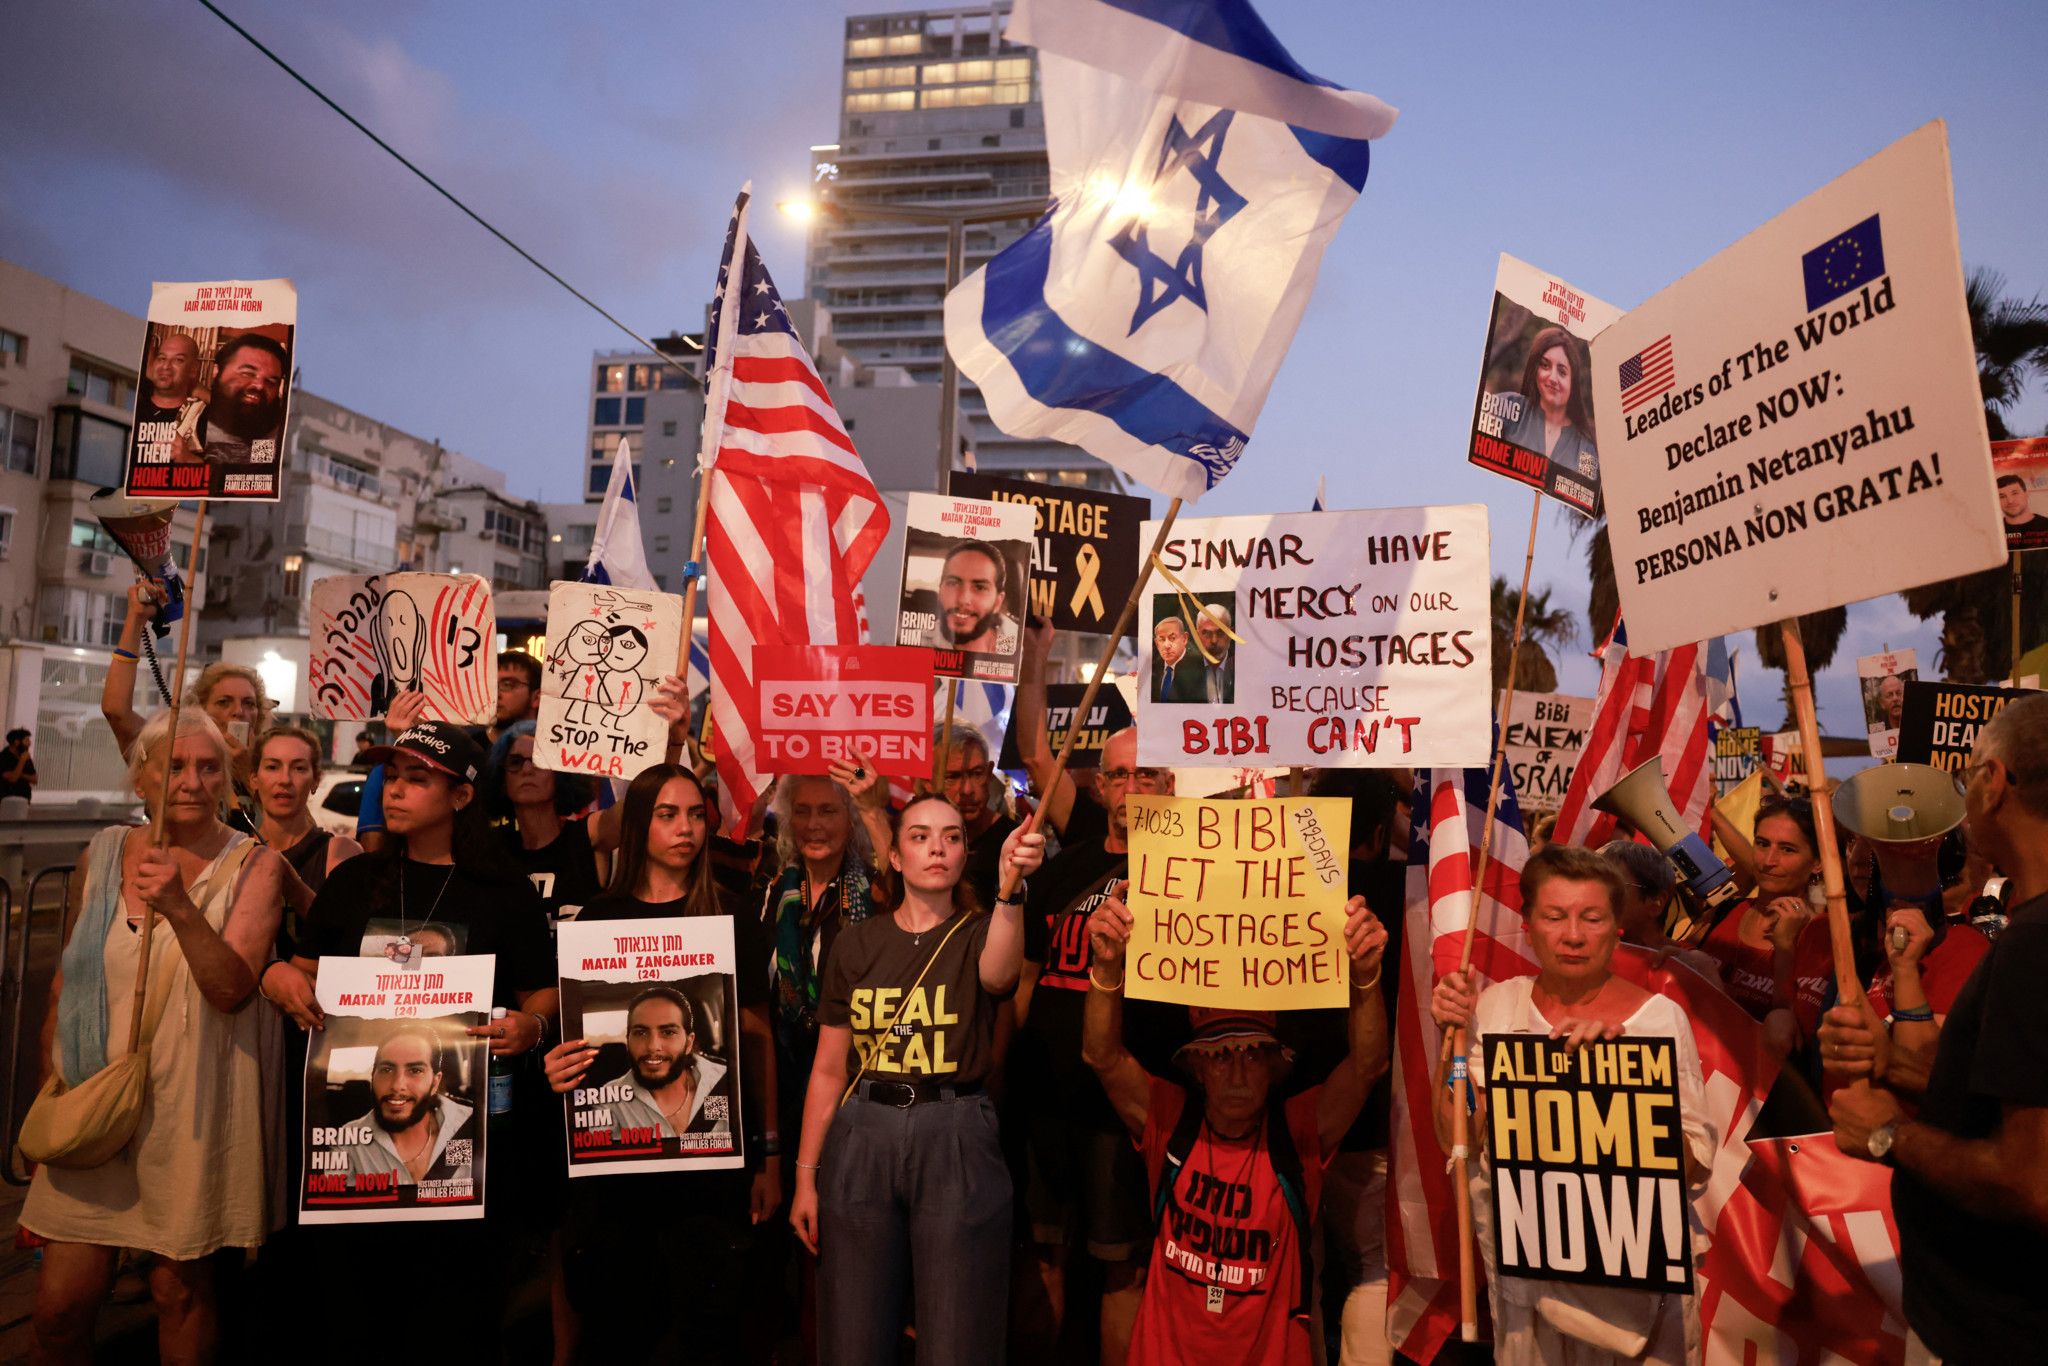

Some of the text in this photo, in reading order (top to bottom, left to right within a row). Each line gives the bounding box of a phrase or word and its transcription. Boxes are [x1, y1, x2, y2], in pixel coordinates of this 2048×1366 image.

[184, 300, 263, 312] IAIR AND EITAN HORN
[1542, 291, 1586, 323] KARINA ARIEV
[1625, 276, 1896, 441] Leaders of The World
[1481, 391, 1521, 422] BRING
[138, 422, 177, 442] BRING
[1477, 411, 1504, 439] HER
[1665, 370, 1844, 471] Declare NOW:
[137, 444, 172, 464] THEM
[1474, 434, 1549, 480] HOME NOW!
[132, 464, 210, 487] HOME NOW!
[1637, 405, 1916, 534] Benjamin Netanyahu
[224, 481, 272, 491] FAMILIES FORUM
[941, 512, 1001, 528] MATAN ZANGAUKER
[992, 490, 1109, 540] STAGE
[1634, 452, 1944, 585] PERSONA NON GRATA!
[963, 525, 977, 537] (24)
[1164, 531, 1452, 571] SINWAR HAVE
[1249, 583, 1459, 620] MERCY ON OUR
[902, 611, 936, 630] BRING
[900, 628, 922, 646] HIM
[1288, 630, 1475, 669] HOSTAGES
[934, 651, 964, 669] NOW!
[772, 693, 914, 718] SAY YES
[1272, 685, 1390, 714] BECAUSE
[1936, 693, 2018, 721] HOSTA
[549, 724, 599, 751] STOP
[1182, 714, 1421, 756] BIBI CAN'T
[1505, 722, 1588, 750] ENEM
[1932, 721, 1985, 747] DEA
[762, 734, 926, 761] TO BIDEN
[1536, 751, 1552, 763] OF
[1513, 763, 1574, 795] SRAE
[1198, 805, 1286, 852] BIBI
[1139, 853, 1216, 902] LET
[1235, 856, 1306, 899] THE
[1155, 908, 1329, 947] HOSTAGES
[614, 934, 683, 955] מתן צנגאוקר
[582, 953, 715, 970] MATAN ZANGAUKER
[638, 969, 660, 980] (24)
[1137, 949, 1342, 988] COME HOME!
[376, 974, 444, 992] מתן צנגאוקר
[339, 992, 473, 1006] MATAN ZANGAUKER
[394, 1006, 417, 1017] (24)
[850, 984, 958, 1030] SEAL
[893, 1025, 914, 1036] THE
[852, 1030, 958, 1075] DEAL
[1492, 1041, 1672, 1087] ALL OF THEM
[573, 1084, 634, 1107] BRING
[574, 1108, 613, 1128] HIM
[1492, 1087, 1679, 1170] HOME
[312, 1126, 374, 1146] BRING
[573, 1123, 662, 1148] HOME NOW!
[680, 1138, 733, 1151] FAMILIES FORUM
[311, 1151, 349, 1170] HIM
[308, 1168, 399, 1194] HOME NOW!
[417, 1186, 473, 1199] FAMILIES FORUM
[1496, 1167, 1686, 1283] NOW!
